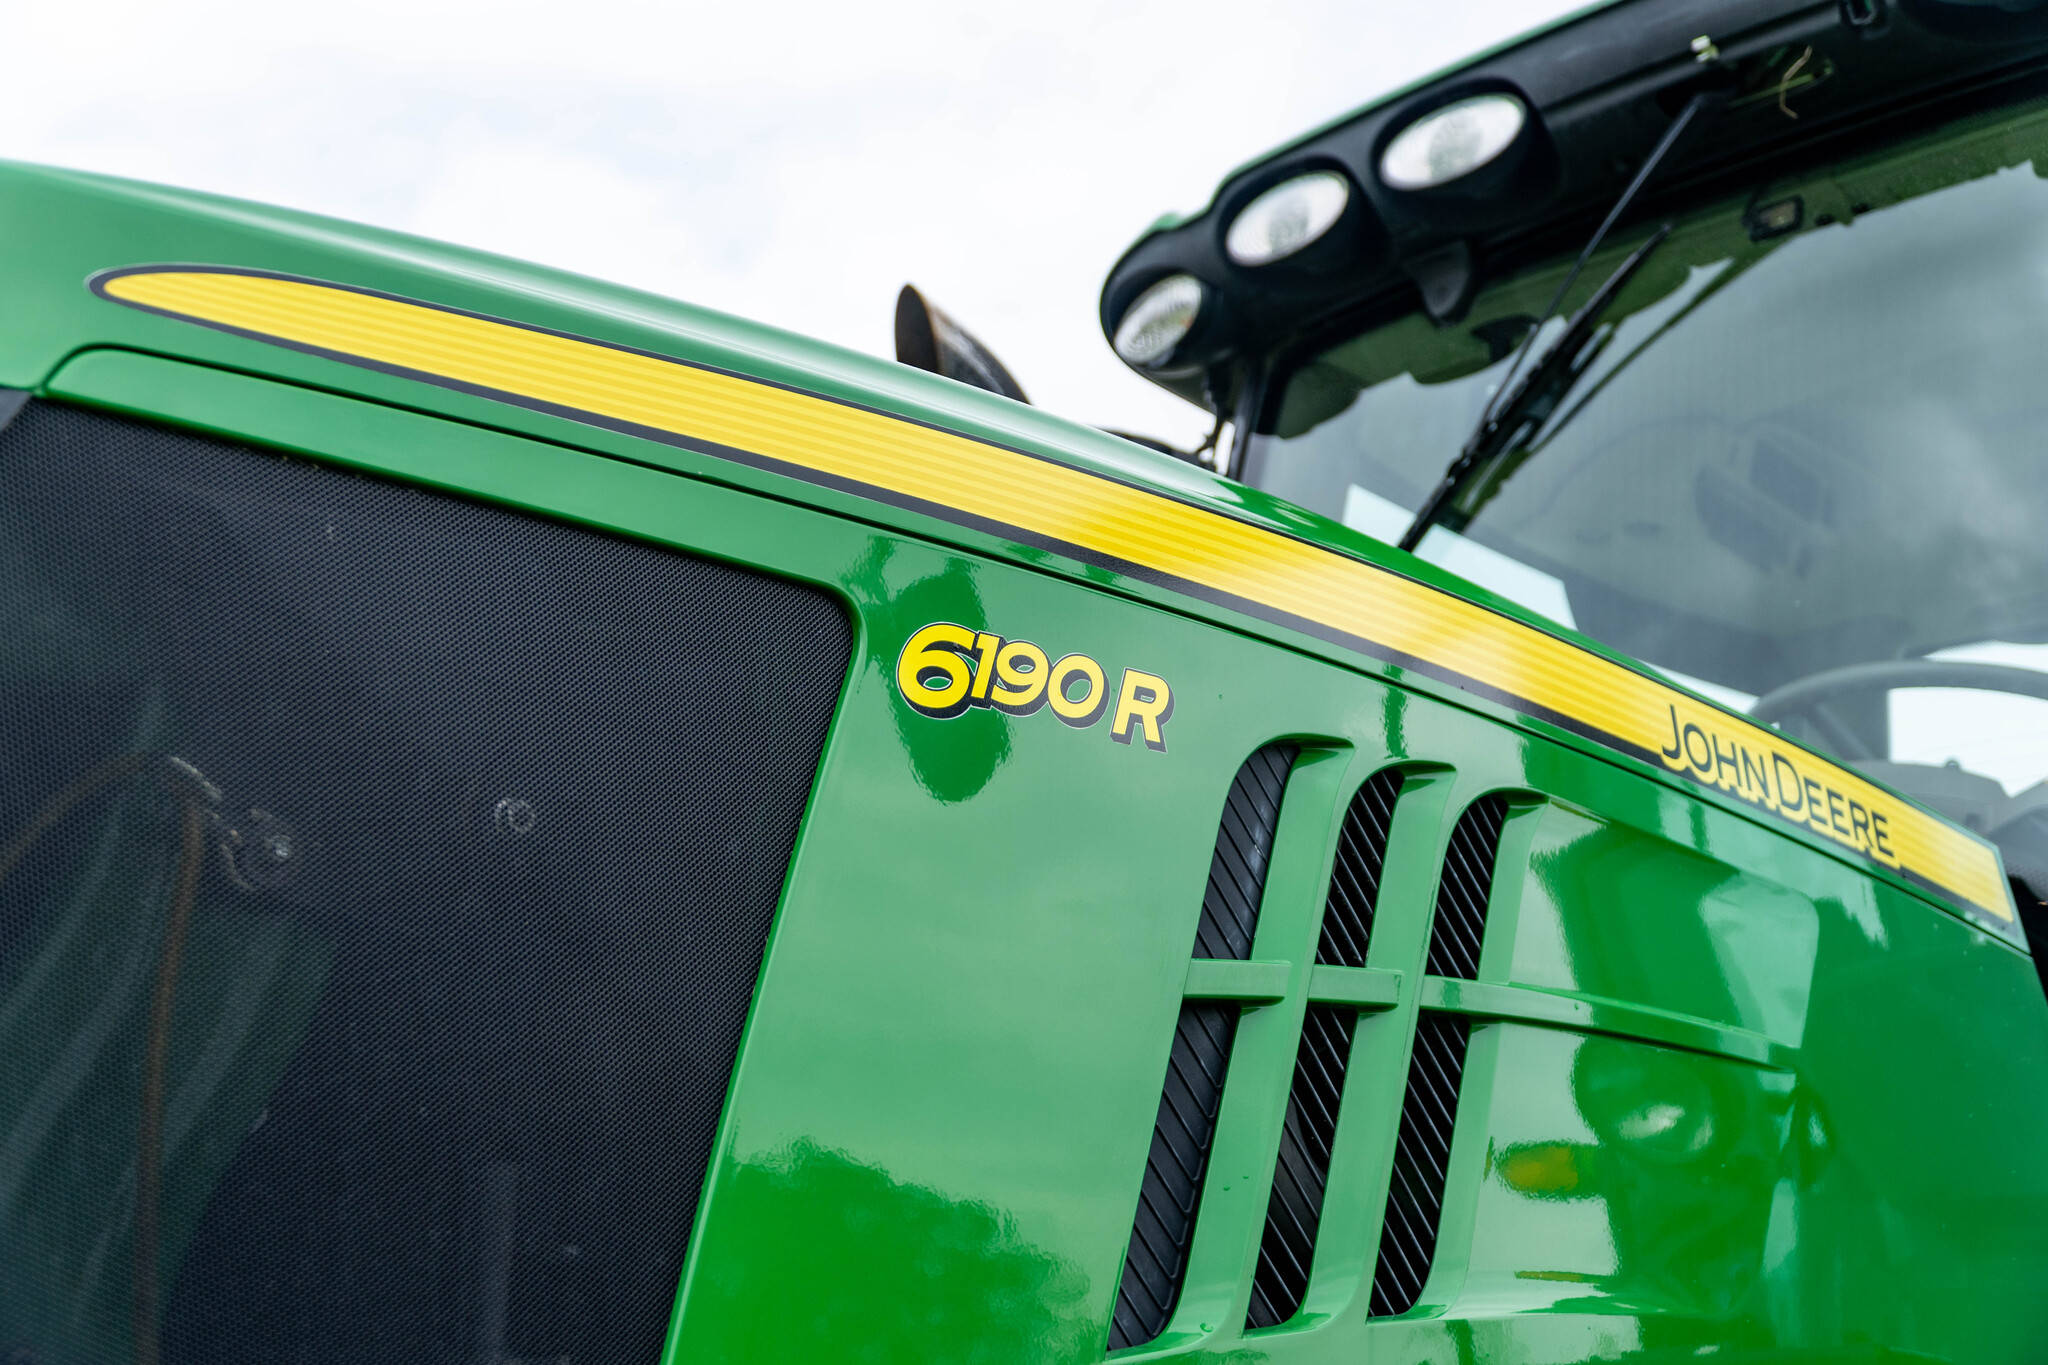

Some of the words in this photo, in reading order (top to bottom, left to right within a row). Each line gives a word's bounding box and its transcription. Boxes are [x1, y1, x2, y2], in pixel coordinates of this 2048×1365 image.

[897, 622, 1109, 728] 6190
[1111, 668, 1174, 752] R
[1661, 703, 1770, 800] JOHN
[1771, 750, 1896, 859] DEERE
